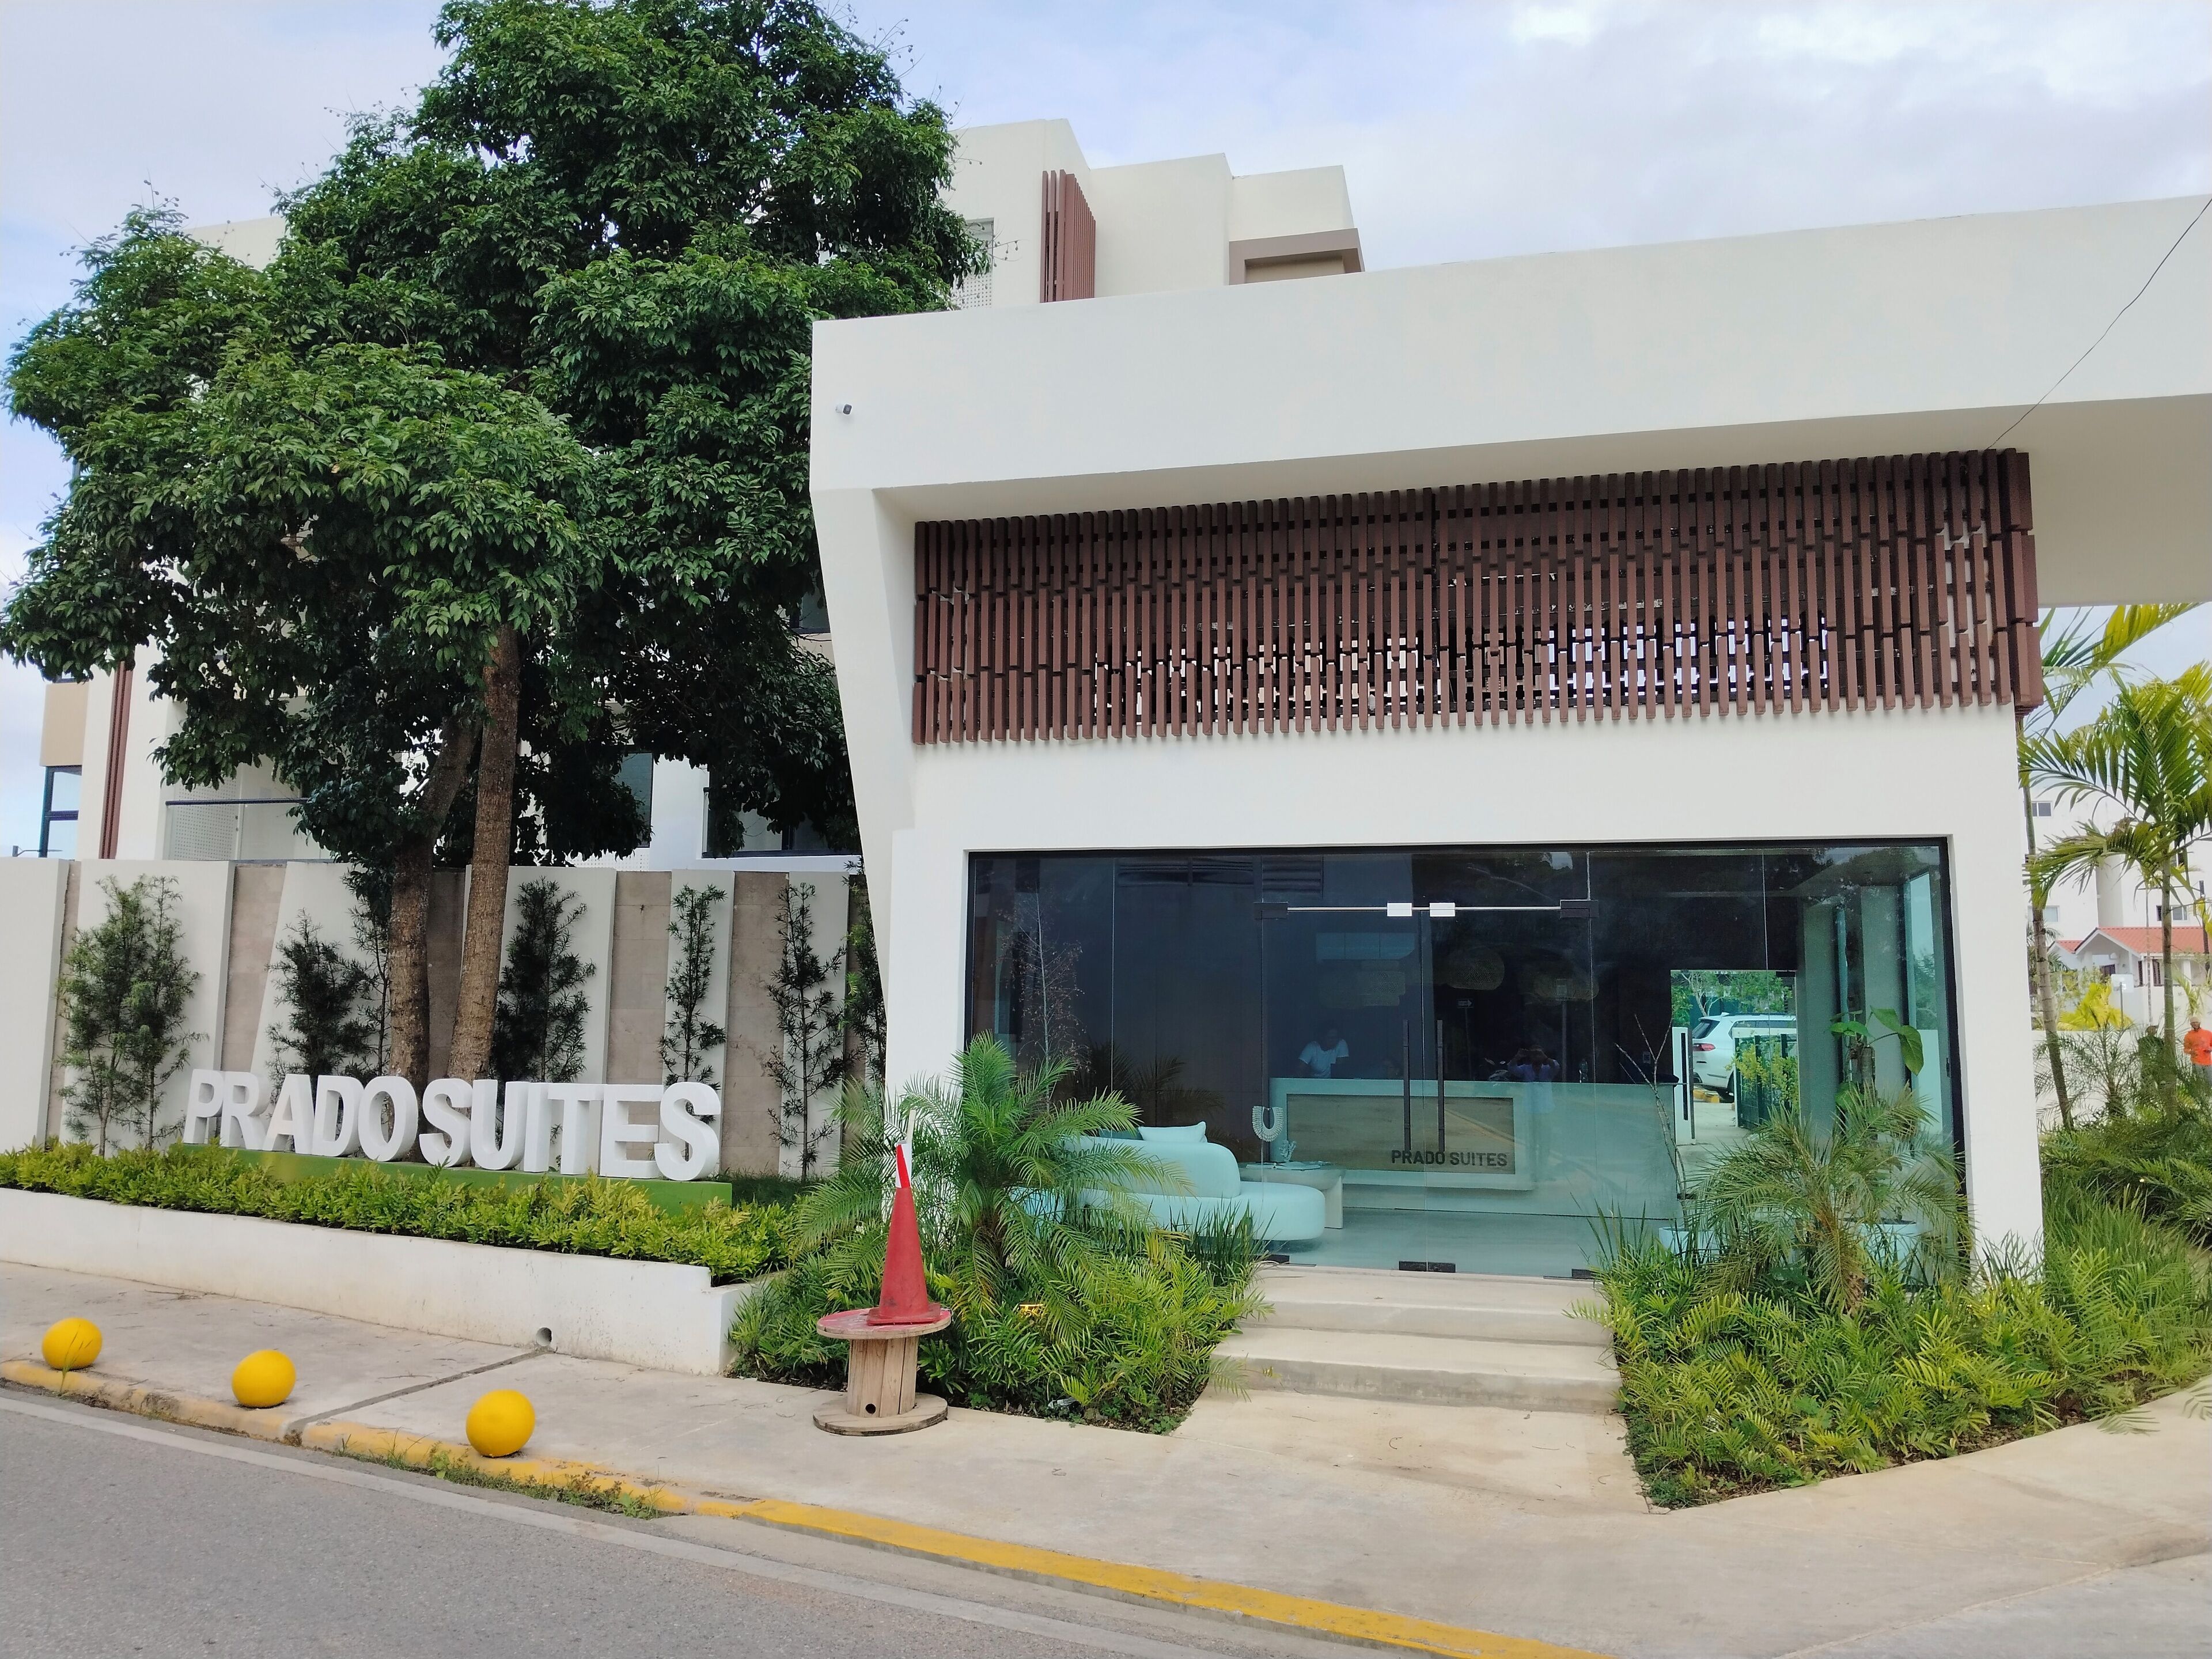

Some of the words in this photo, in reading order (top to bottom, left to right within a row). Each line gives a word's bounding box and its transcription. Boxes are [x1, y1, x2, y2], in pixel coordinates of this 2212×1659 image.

[183, 1069, 419, 1162] PRADO
[419, 1078, 721, 1181] SUITES
[1391, 1150, 1445, 1165] PRADO
[1449, 1152, 1508, 1166] SUITES
